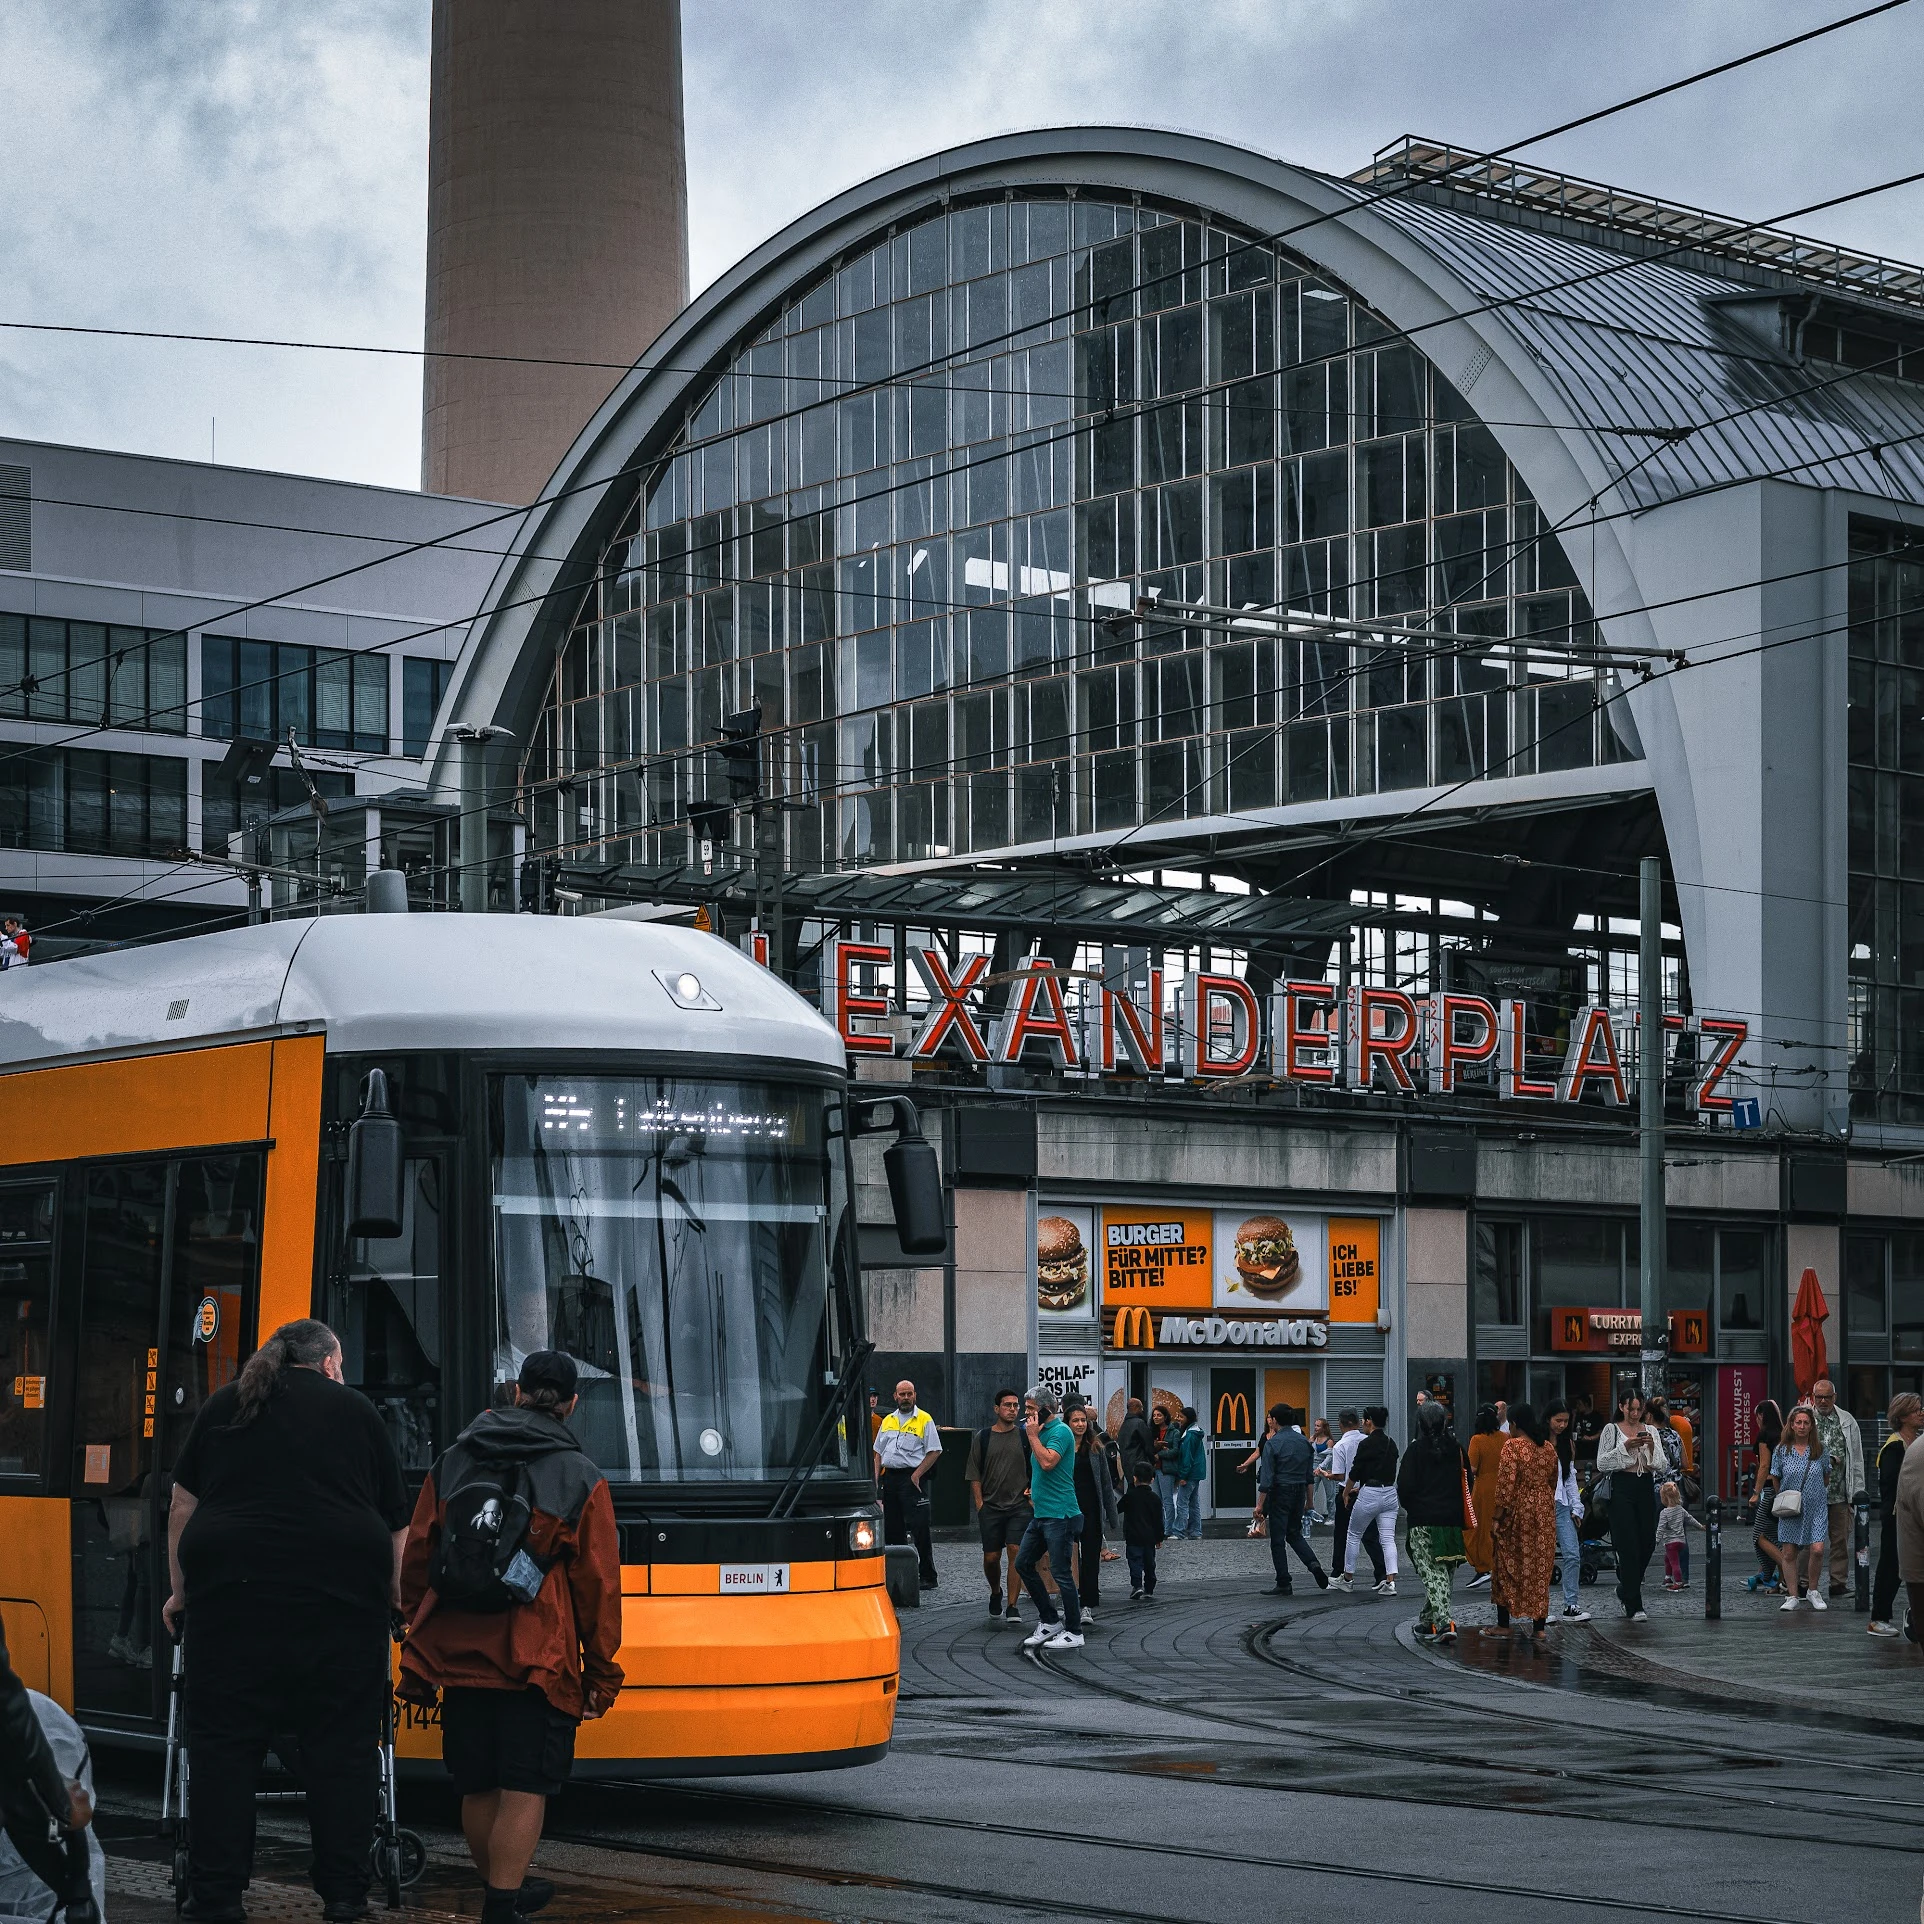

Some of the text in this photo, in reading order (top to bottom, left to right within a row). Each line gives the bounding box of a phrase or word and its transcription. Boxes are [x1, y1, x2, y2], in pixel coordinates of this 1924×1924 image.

[1107, 1224, 1184, 1246] BURGER
[1144, 1246, 1207, 1267] MITTE?
[1332, 1244, 1358, 1261] ICH
[1333, 1260, 1375, 1278] LIEBE
[1108, 1268, 1165, 1289] BITTE!
[1592, 1314, 1675, 1330] CURRYWT
[1158, 1316, 1328, 1347] McDonald's
[1609, 1332, 1642, 1346] EXPR
[1039, 1380, 1080, 1397] OS IN
[1743, 1392, 1751, 1445] EXPRESS
[725, 1572, 764, 1585] BERLIN
